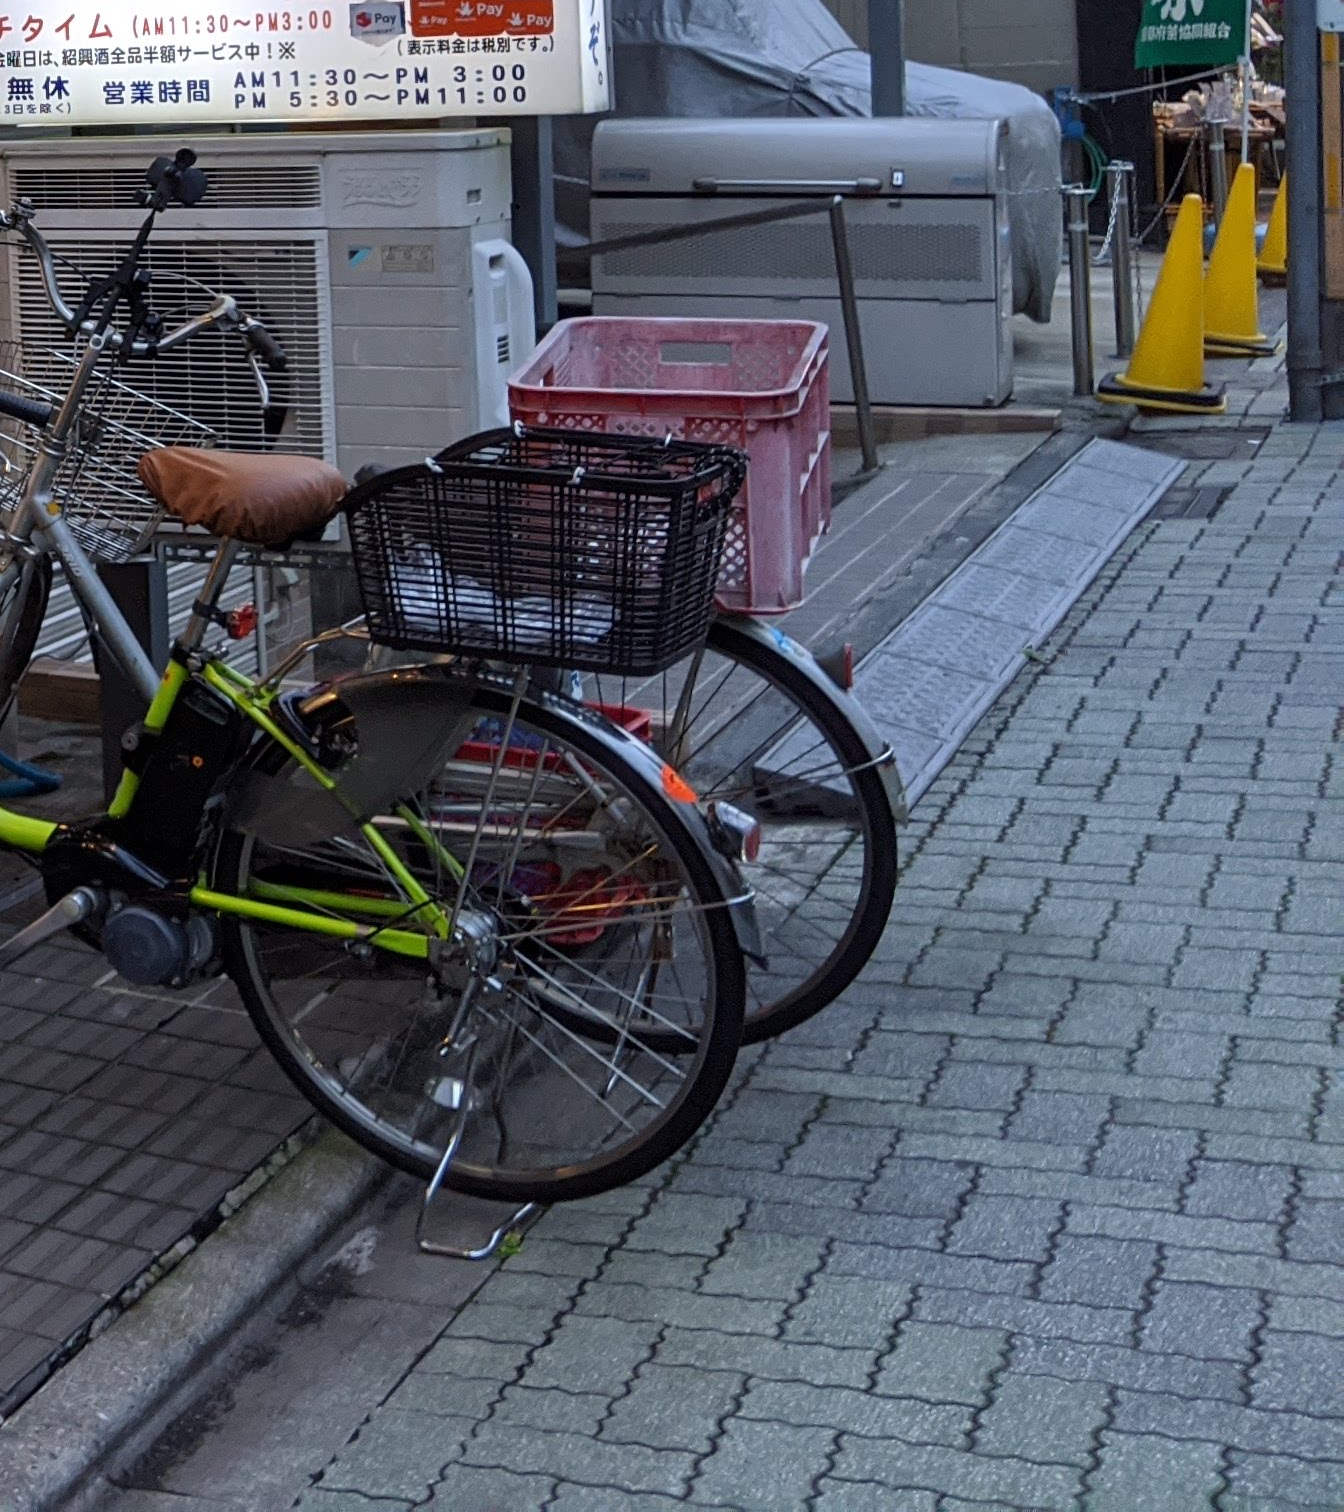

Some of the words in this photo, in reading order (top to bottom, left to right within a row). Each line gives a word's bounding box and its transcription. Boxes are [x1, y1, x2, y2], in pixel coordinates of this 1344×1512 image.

[477, 3, 504, 17] Pay
[374, 14, 397, 25] Pay
[526, 15, 552, 27] Pay
[103, 79, 211, 105] 営業時間
